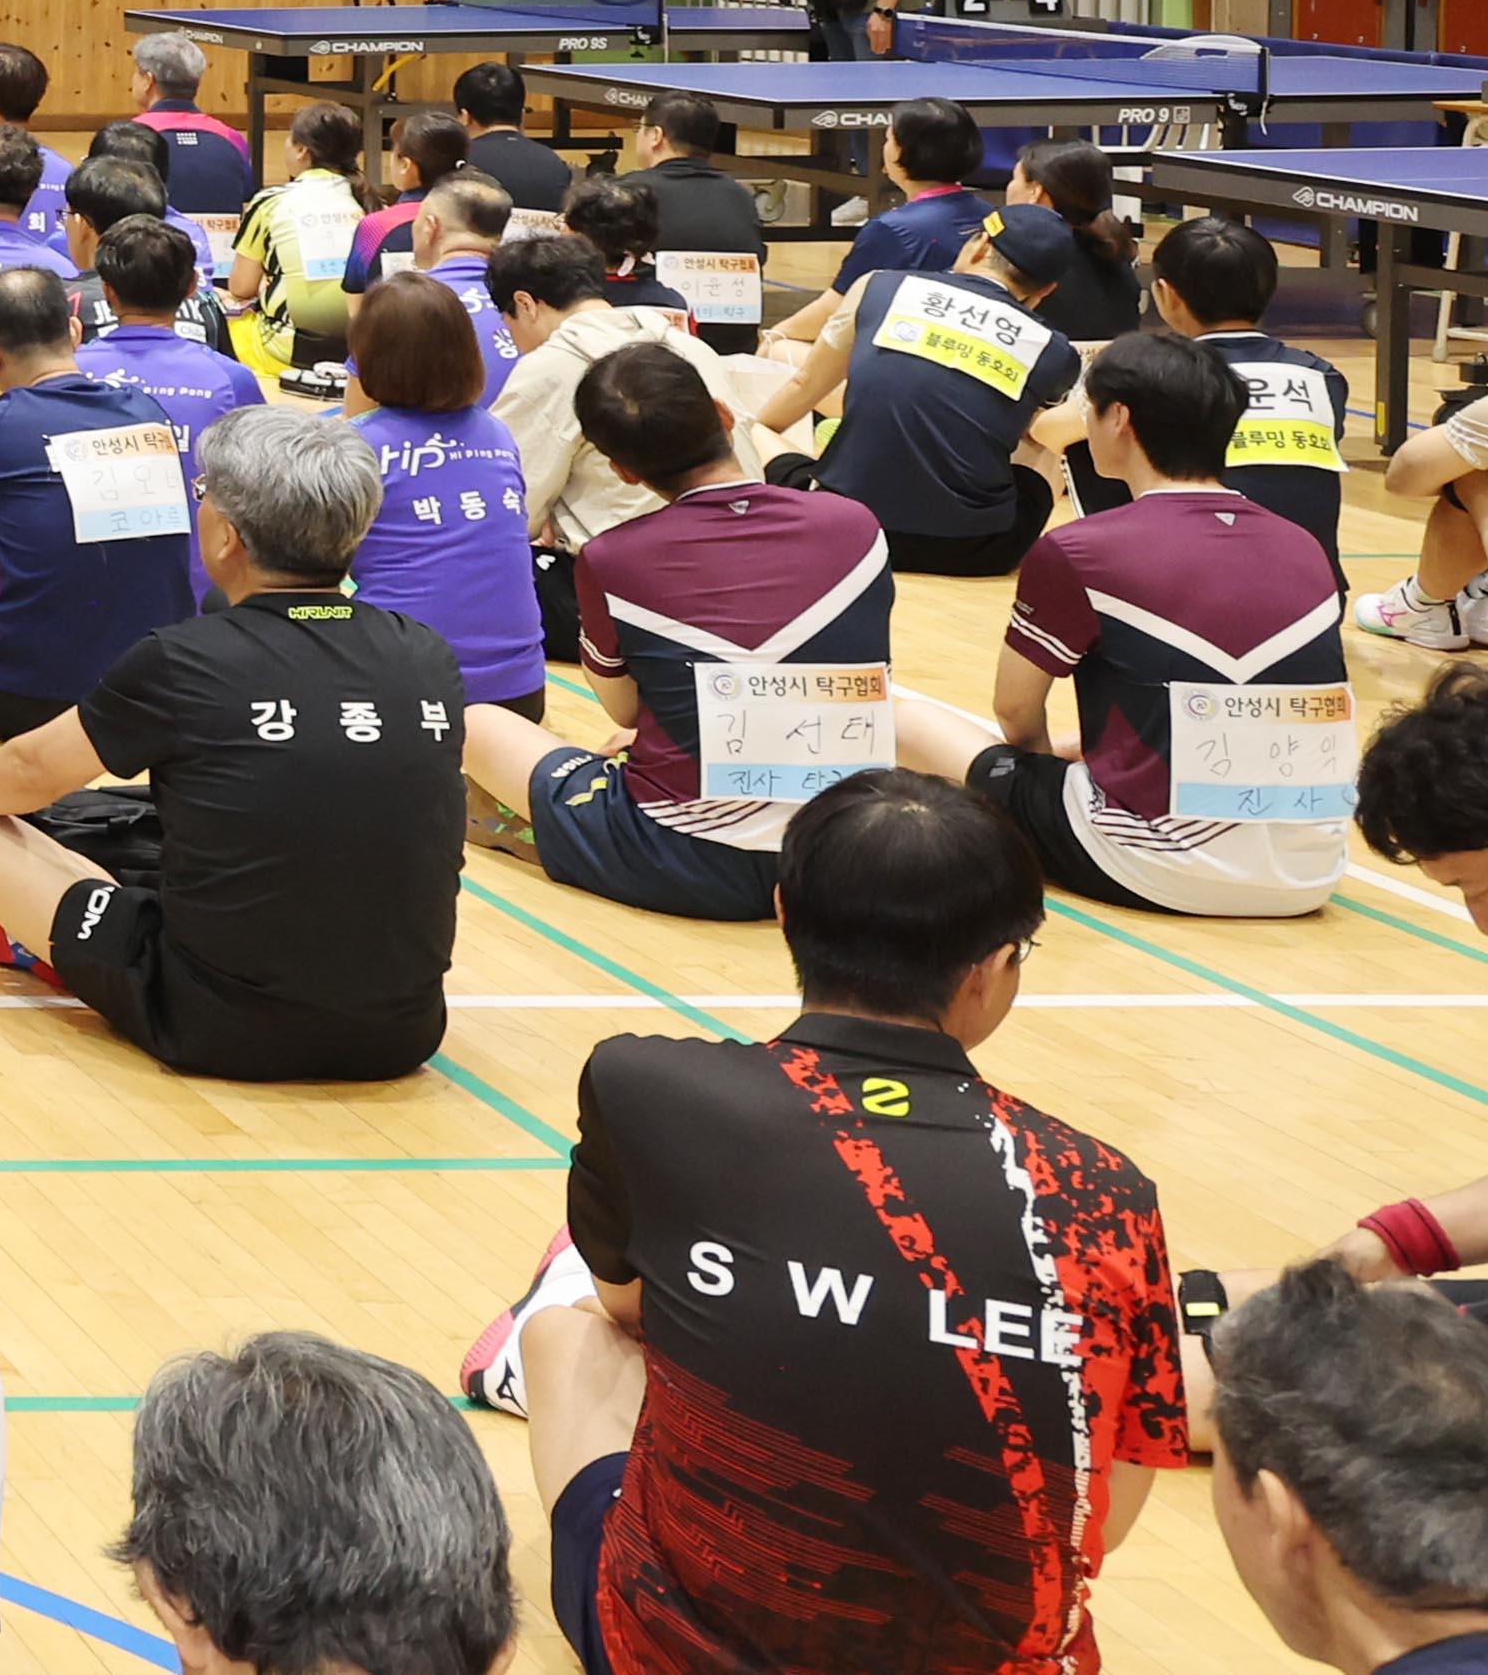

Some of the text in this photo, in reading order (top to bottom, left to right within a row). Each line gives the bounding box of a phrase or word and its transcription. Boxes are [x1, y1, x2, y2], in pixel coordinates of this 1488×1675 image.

[332, 36, 608, 54] CHAMPION PRO 9S
[1117, 107, 1158, 123] PRO
[1316, 192, 1419, 220] CHAMPION
[919, 289, 1024, 347] 황선영
[925, 329, 1021, 382] 블루밍 동호회
[91, 436, 139, 456] 안성시
[1228, 429, 1285, 452] 블루밍
[747, 672, 884, 701] 안성시 탁구협회
[1223, 695, 1284, 720] 안성시
[686, 1240, 1084, 1368] S W LEE
